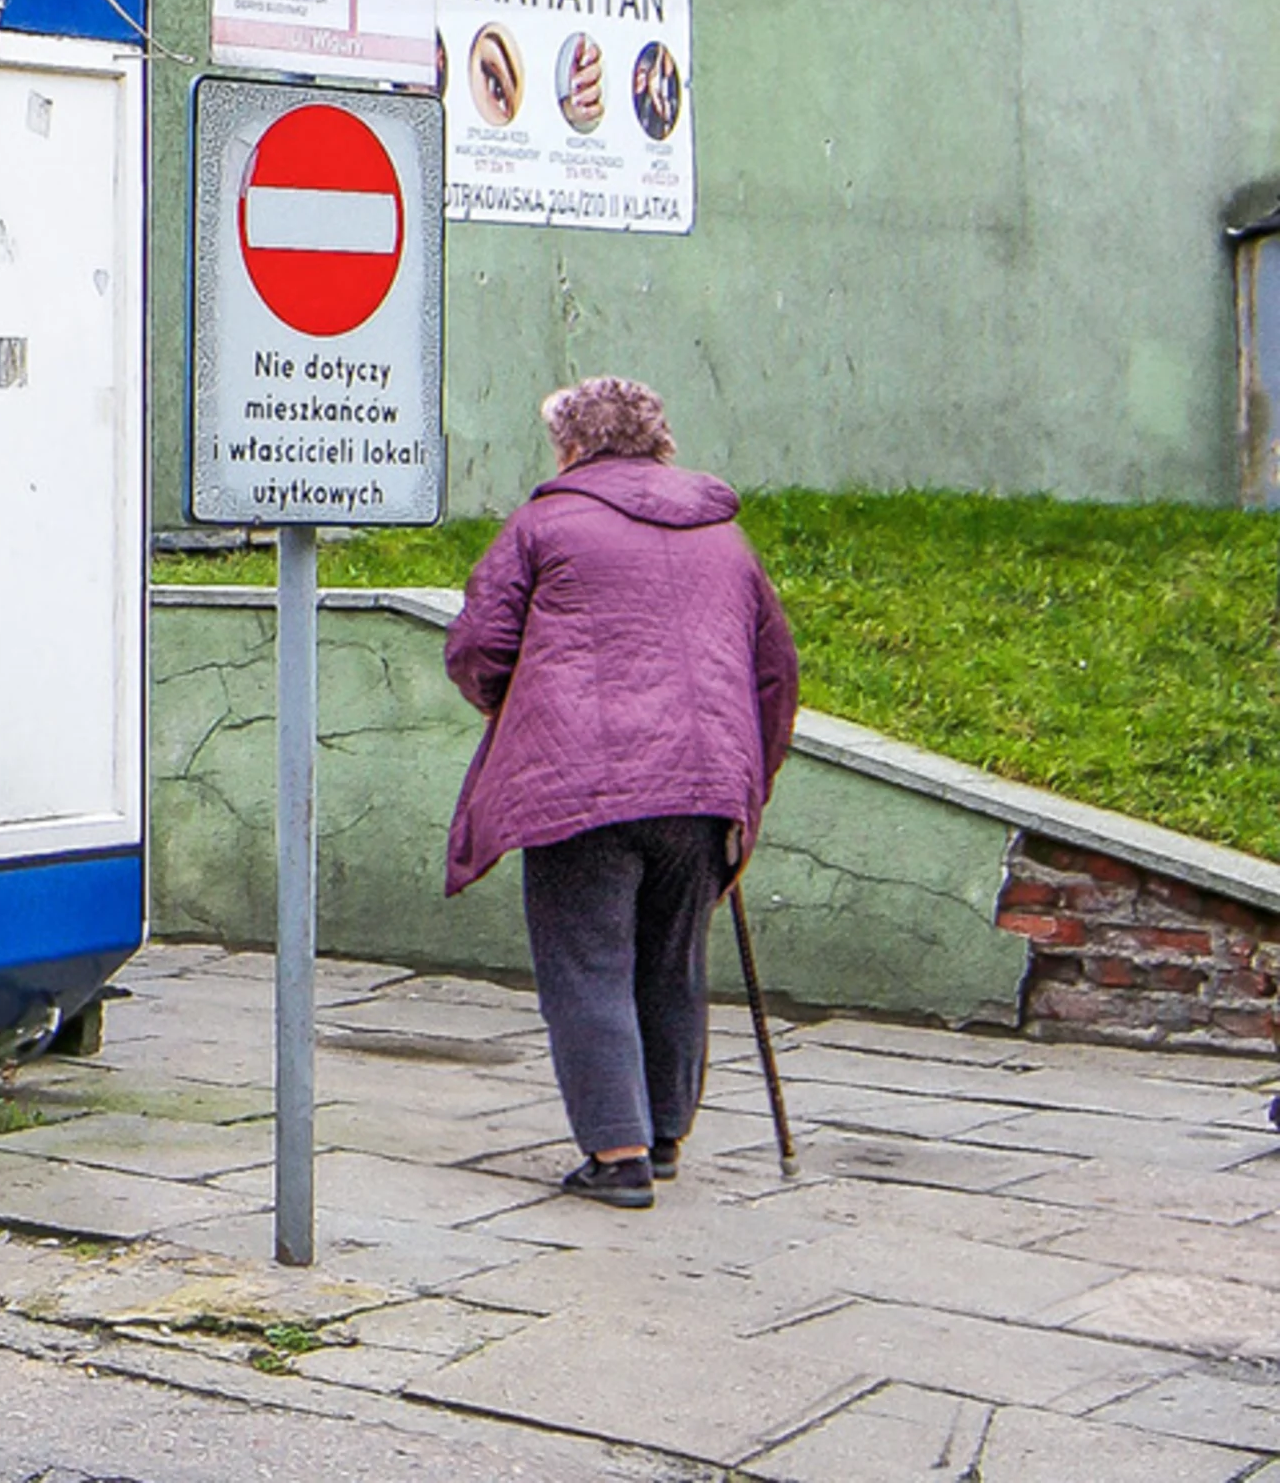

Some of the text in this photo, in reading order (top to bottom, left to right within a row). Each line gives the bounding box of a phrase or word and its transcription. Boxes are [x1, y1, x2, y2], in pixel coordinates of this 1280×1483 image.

[548, 188, 605, 219] 204/210
[623, 195, 682, 221] KLATKA
[253, 350, 392, 390] Nie dotyczy
[245, 394, 398, 425] mieszkańców
[212, 435, 426, 467] i właścicieli lokali
[253, 475, 384, 517] użytkowych
